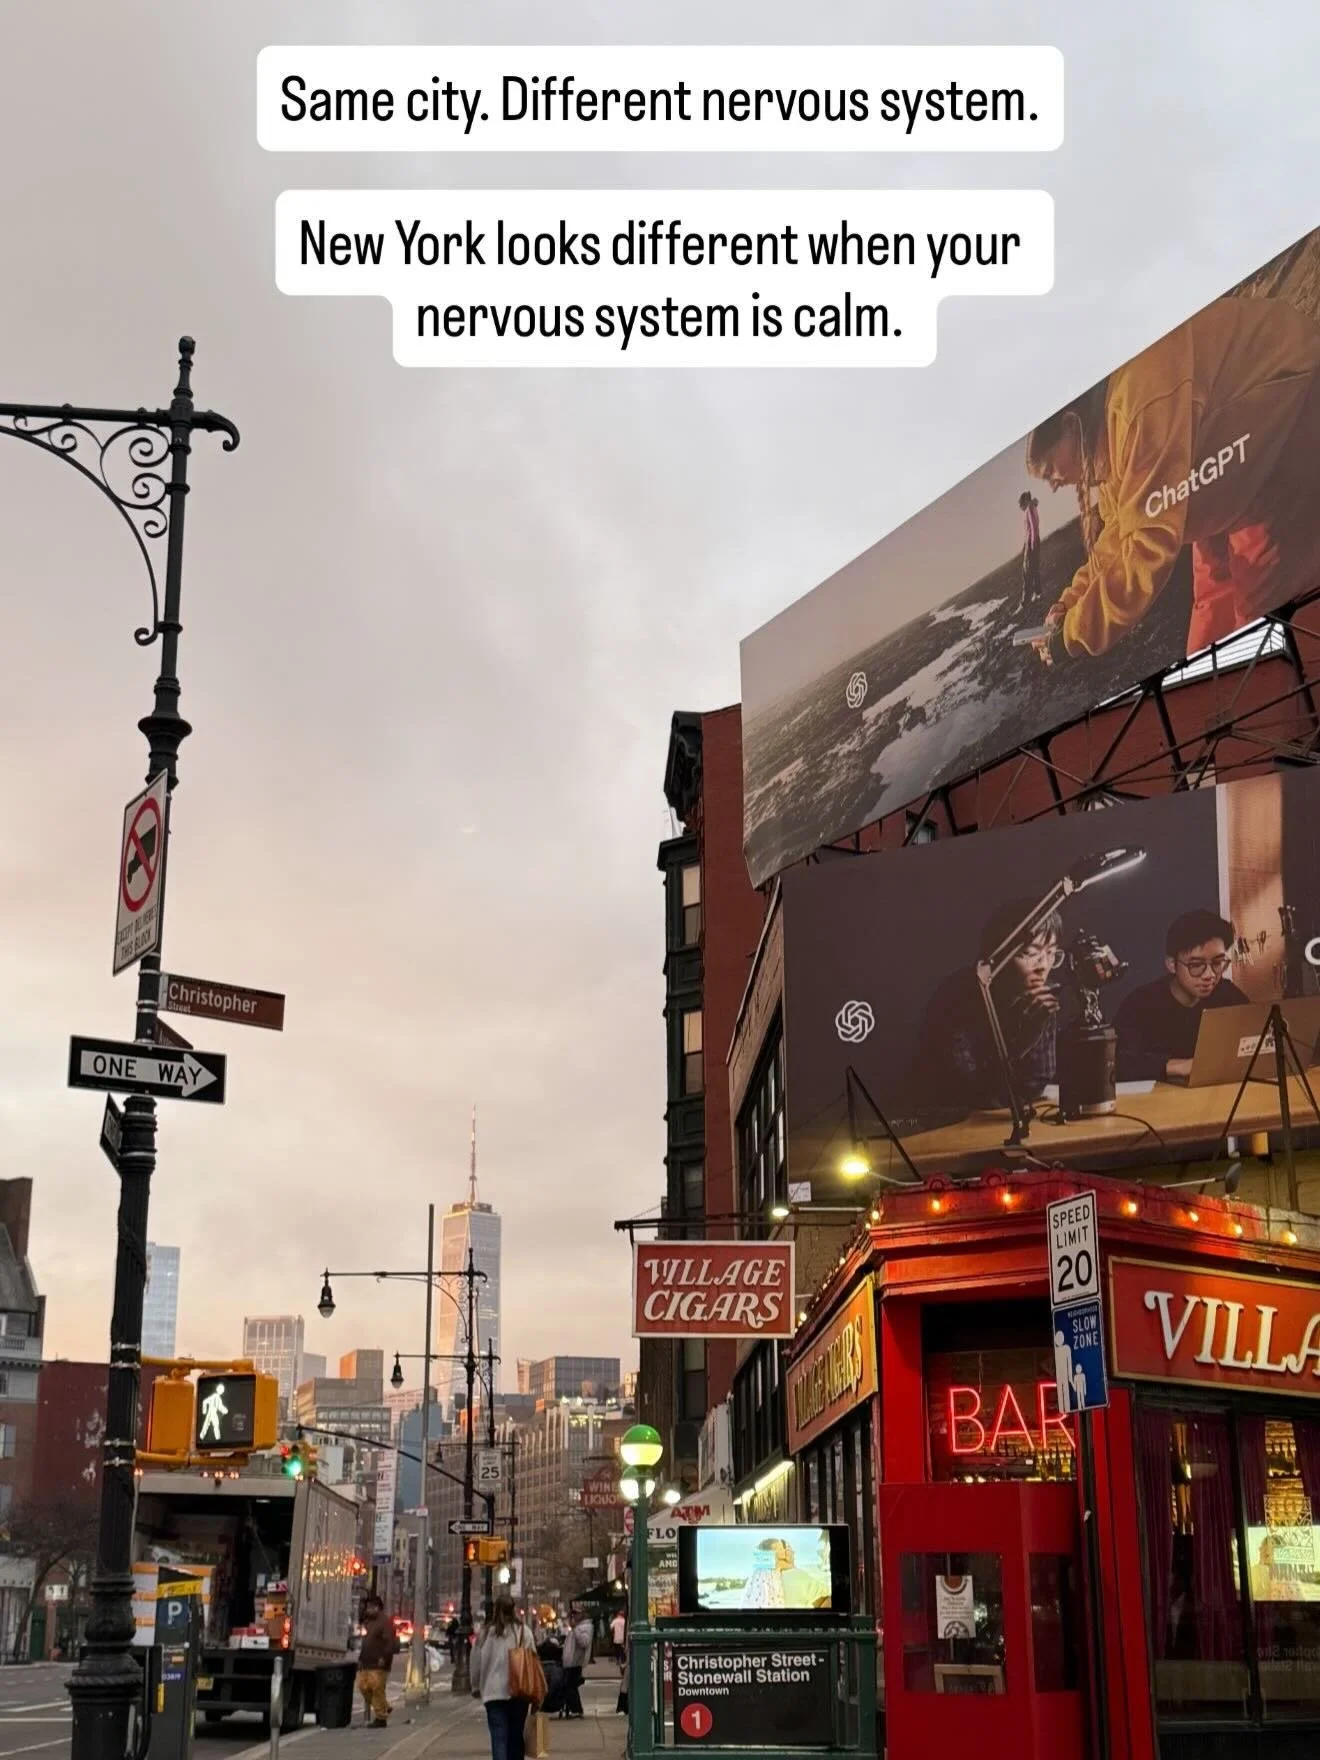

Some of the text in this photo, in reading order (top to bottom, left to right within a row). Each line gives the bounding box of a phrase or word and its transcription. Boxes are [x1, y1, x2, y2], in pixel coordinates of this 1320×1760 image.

[1145, 433, 1250, 518] ChatGPT
[168, 982, 257, 1014] Christopher
[168, 1001, 191, 1014] Street
[93, 1055, 203, 1086] ONE WAY
[1052, 1204, 1090, 1229] SPEED
[1056, 1225, 1089, 1249] LIMIT
[644, 1258, 786, 1286] VILLAGE
[1057, 1250, 1093, 1293] 20
[643, 1290, 784, 1329] CIGARS
[1072, 1314, 1097, 1334] SLOW
[1073, 1331, 1099, 1350] ZONE
[949, 1383, 1077, 1454] BAR
[481, 1466, 500, 1479] 25
[167, 1601, 183, 1625] P
[677, 1654, 767, 1675] Christopher
[677, 1669, 810, 1686] Stonewall Station
[678, 1687, 730, 1697] Downtown
[691, 1710, 701, 1730] 1
